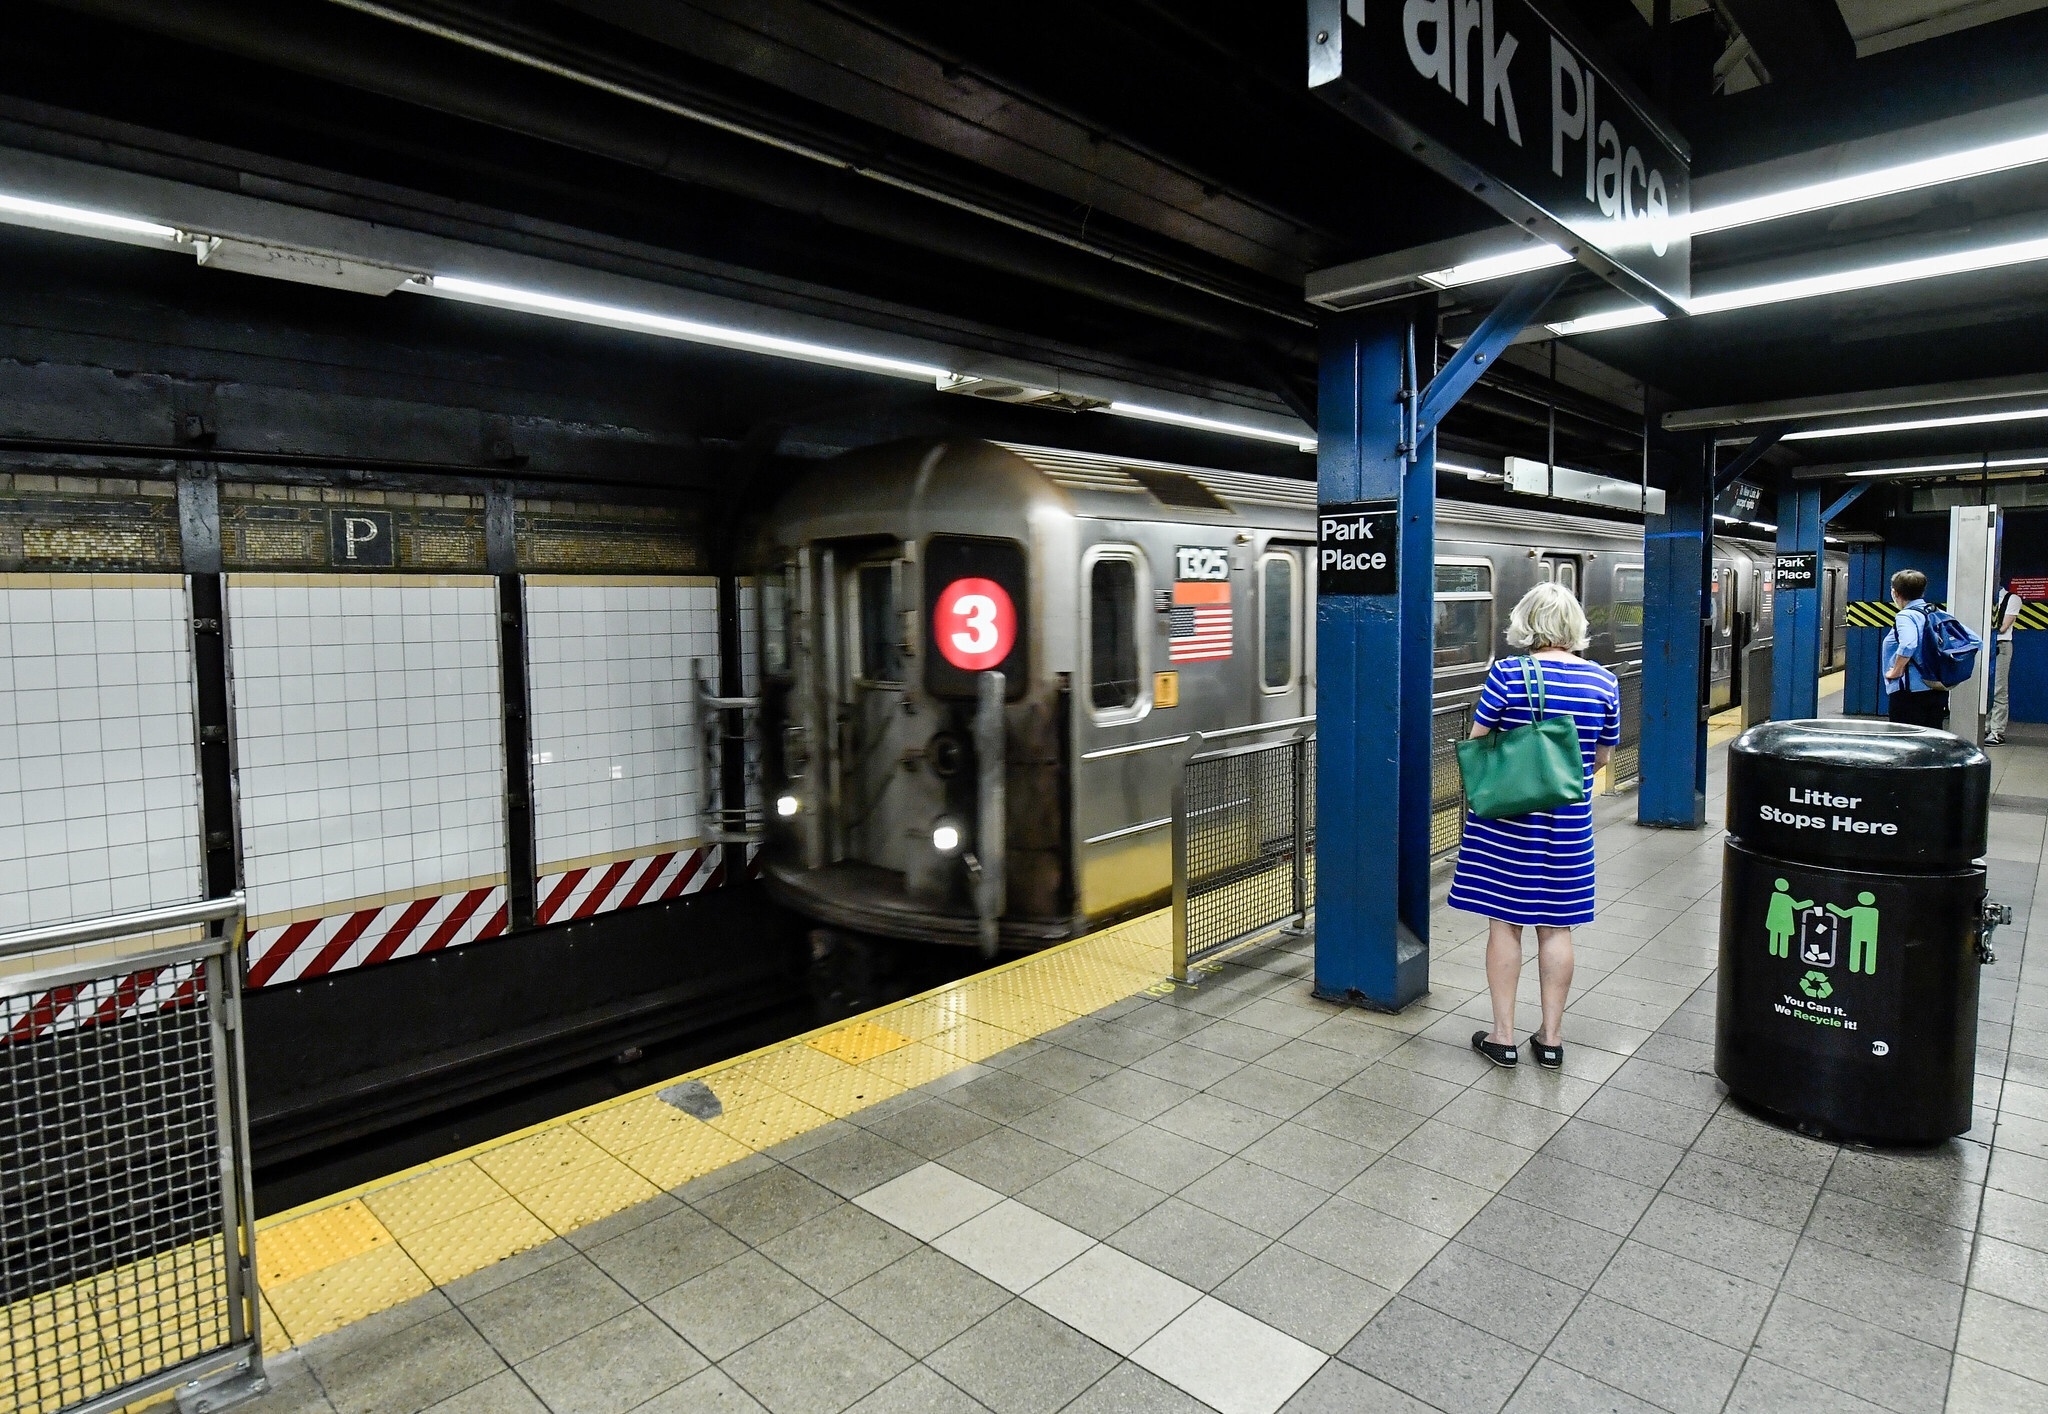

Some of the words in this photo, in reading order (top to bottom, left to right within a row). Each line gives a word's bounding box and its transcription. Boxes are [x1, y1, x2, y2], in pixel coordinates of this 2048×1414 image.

[1347, 0, 1523, 147] ark
[1550, 35, 1669, 257] Place
[344, 517, 378, 559] P
[1322, 517, 1374, 541] Park
[1176, 548, 1228, 579] 1325
[1322, 549, 1387, 571] Place
[1777, 558, 1805, 568] Park
[1777, 570, 1811, 579] Place
[951, 595, 998, 654] 3
[1789, 787, 1862, 809] Litter
[1760, 805, 1826, 829] Stops
[1832, 815, 1898, 835] Here
[1774, 1003, 1792, 1016] We
[1793, 1009, 1842, 1027] Recycle
[1844, 1020, 1858, 1030] it!
[1783, 995, 1804, 1007] You
[1807, 1001, 1832, 1014] Can
[1833, 1006, 1847, 1017] it.
